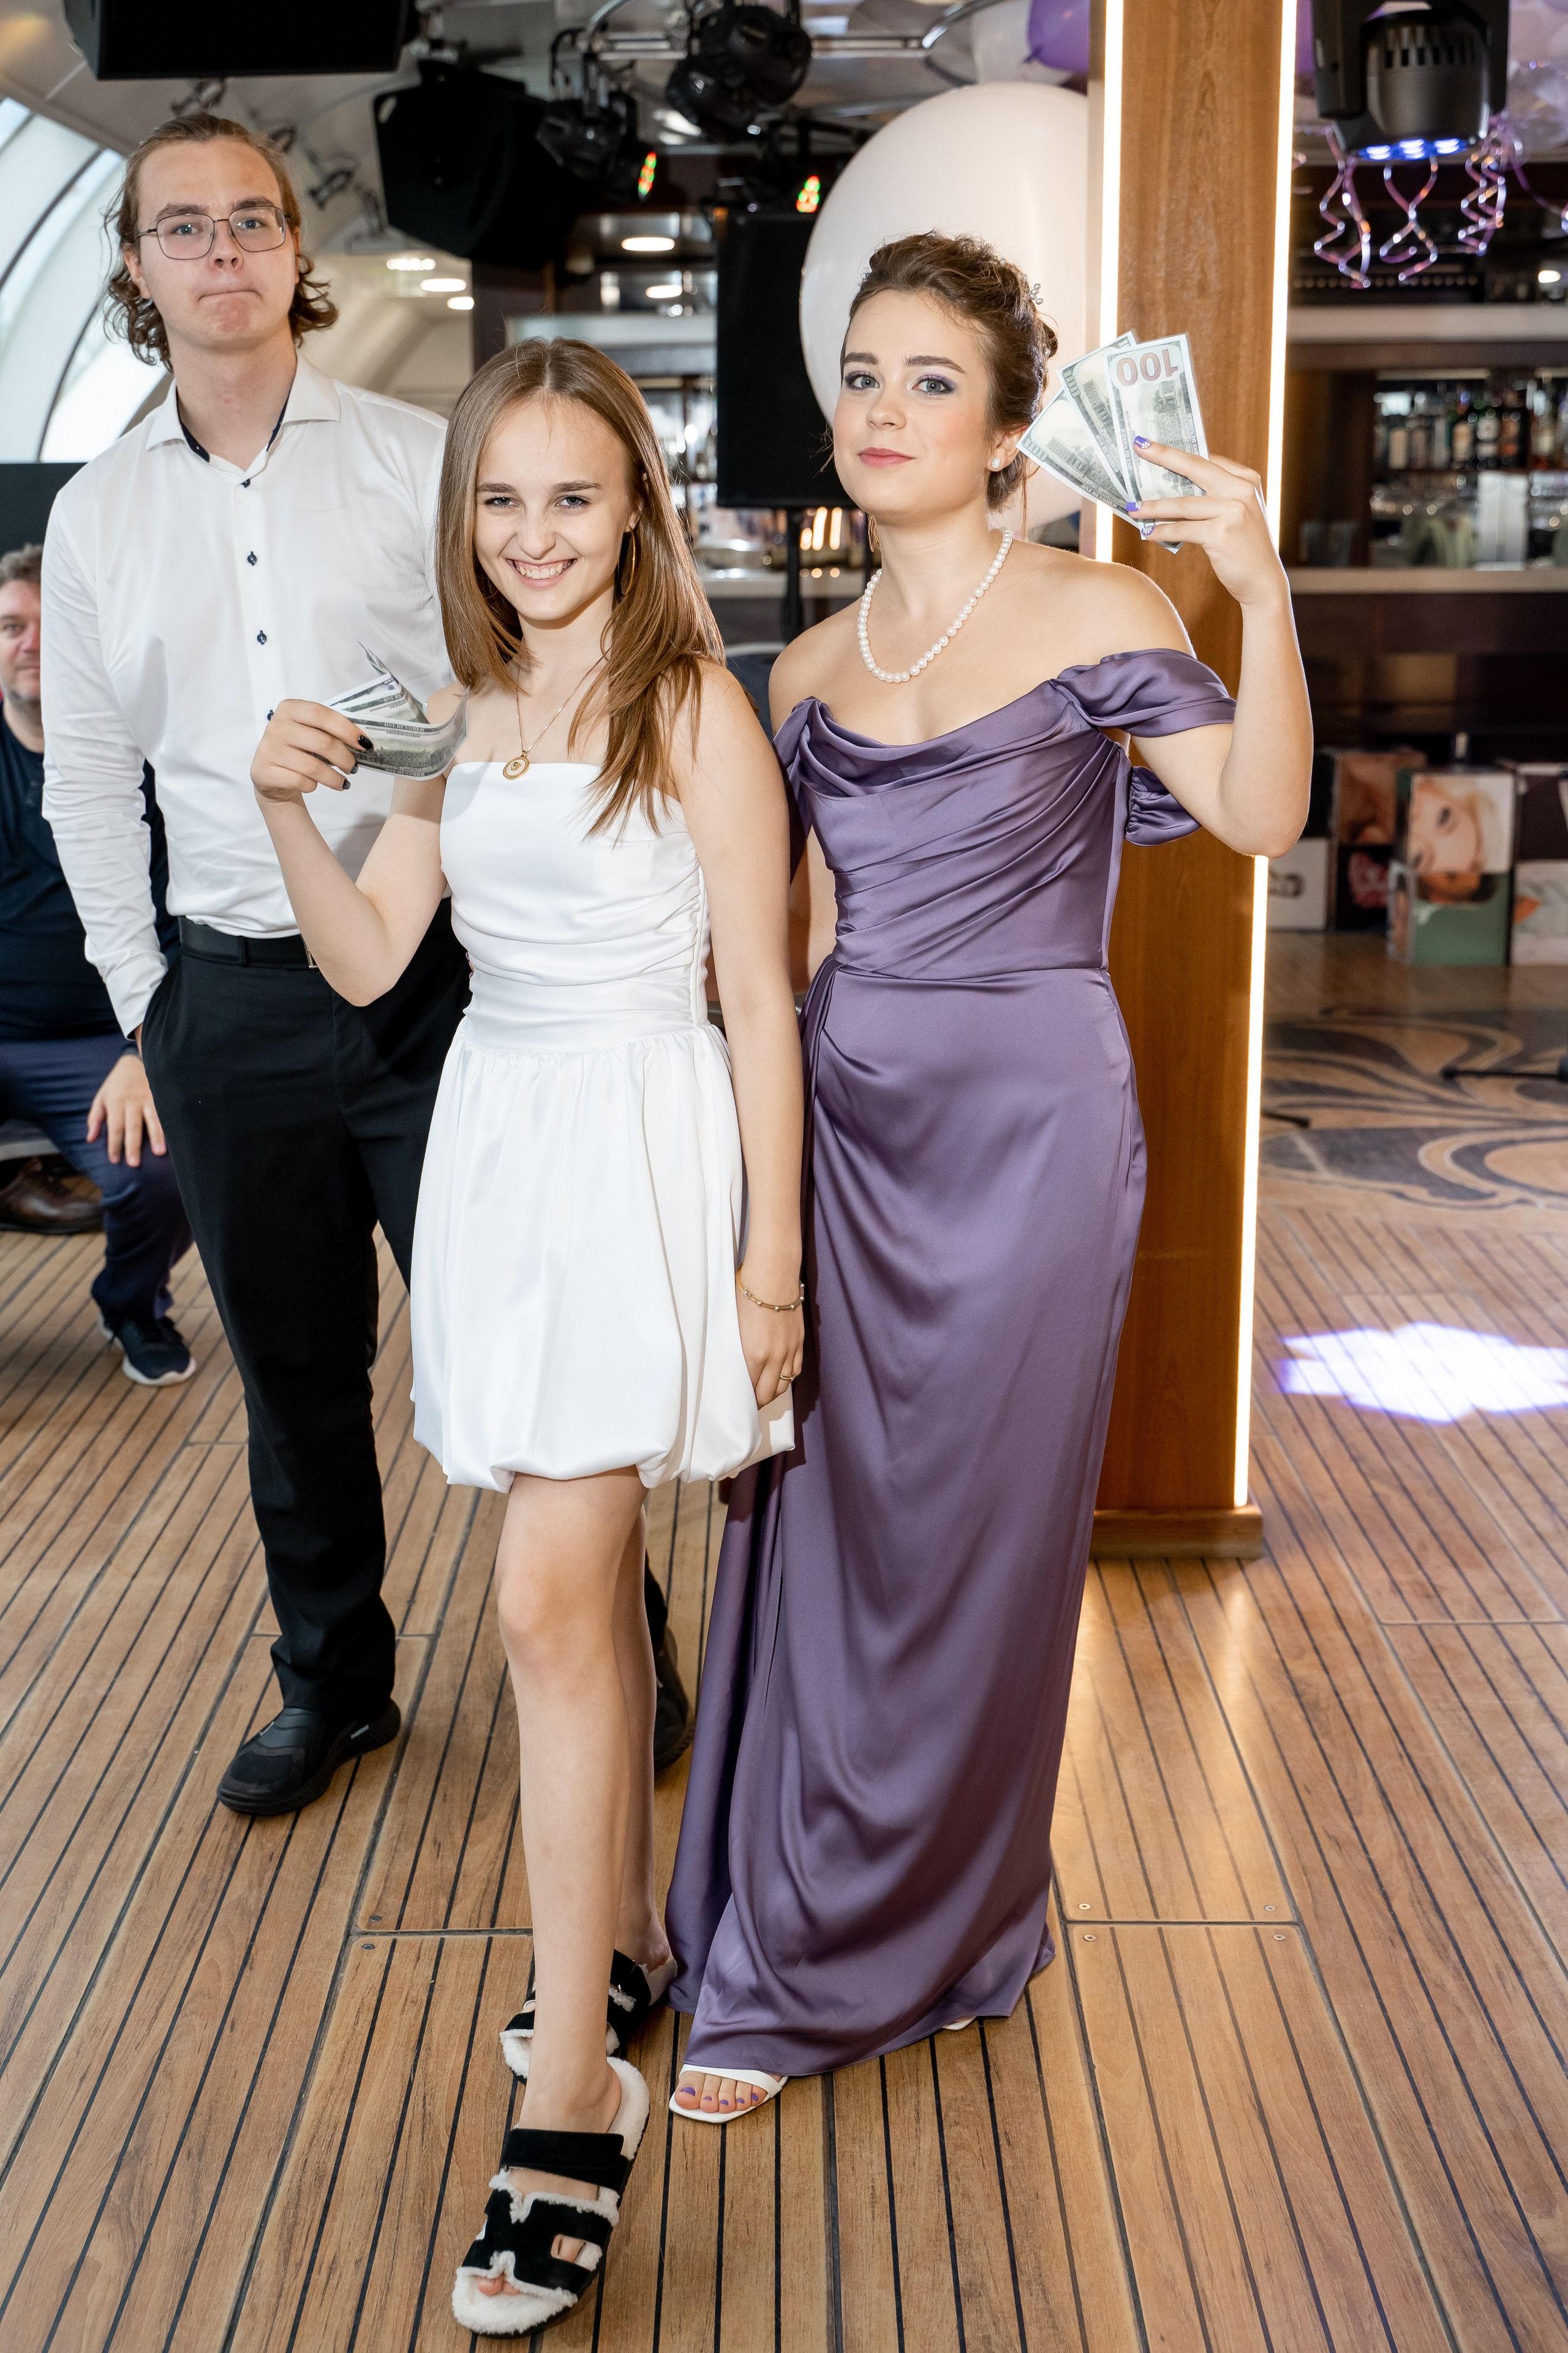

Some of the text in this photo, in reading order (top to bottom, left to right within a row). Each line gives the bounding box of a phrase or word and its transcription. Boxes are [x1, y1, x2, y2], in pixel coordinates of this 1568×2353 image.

[1117, 349, 1179, 387] 100
[1095, 434, 1105, 447] ONE
[1101, 445, 1120, 473] HUNDRED
[1080, 483, 1093, 494] ONE
[1091, 490, 1117, 509] HUNDRED
